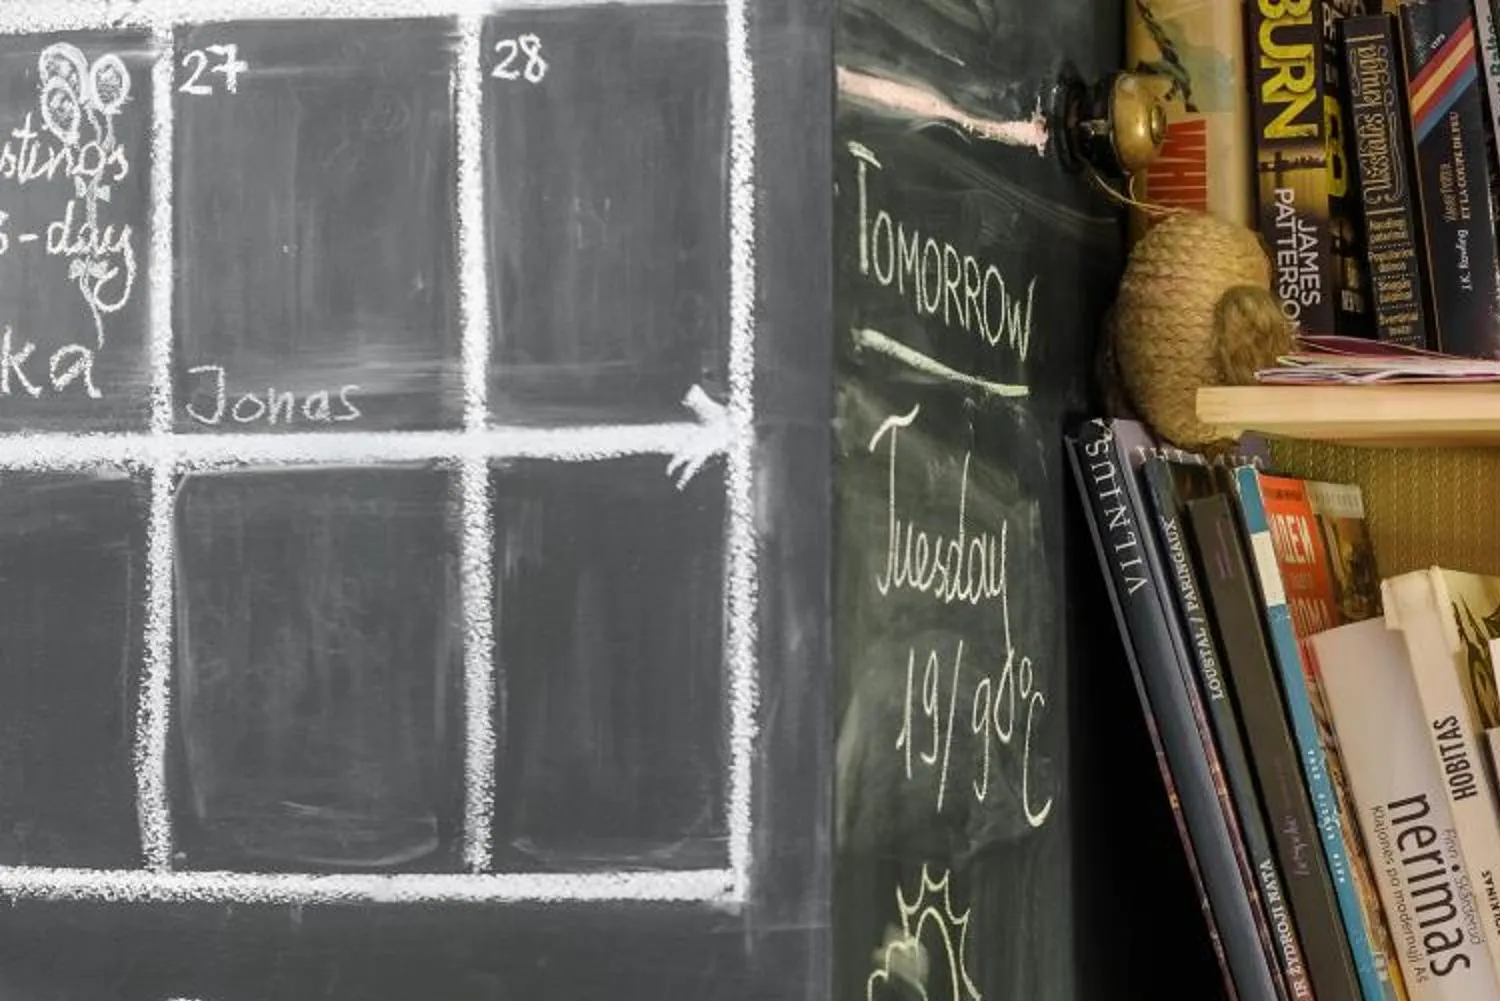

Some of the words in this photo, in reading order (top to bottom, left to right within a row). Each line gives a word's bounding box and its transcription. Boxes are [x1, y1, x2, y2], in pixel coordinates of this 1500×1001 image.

[180, 44, 248, 95] 27
[493, 34, 548, 83] 28
[1258, 0, 1317, 138] BURN
[848, 141, 1038, 362] TOMORROW
[1296, 219, 1320, 306] JAMES
[187, 365, 362, 425] Jonas
[1086, 441, 1149, 596] VILNIUS
[869, 404, 1016, 738] Tuesday
[1195, 619, 1225, 701] LOUSTAL
[1433, 715, 1478, 801] HOBITAS
[1257, 858, 1282, 903] NATA
[1388, 793, 1470, 977] nerimas
